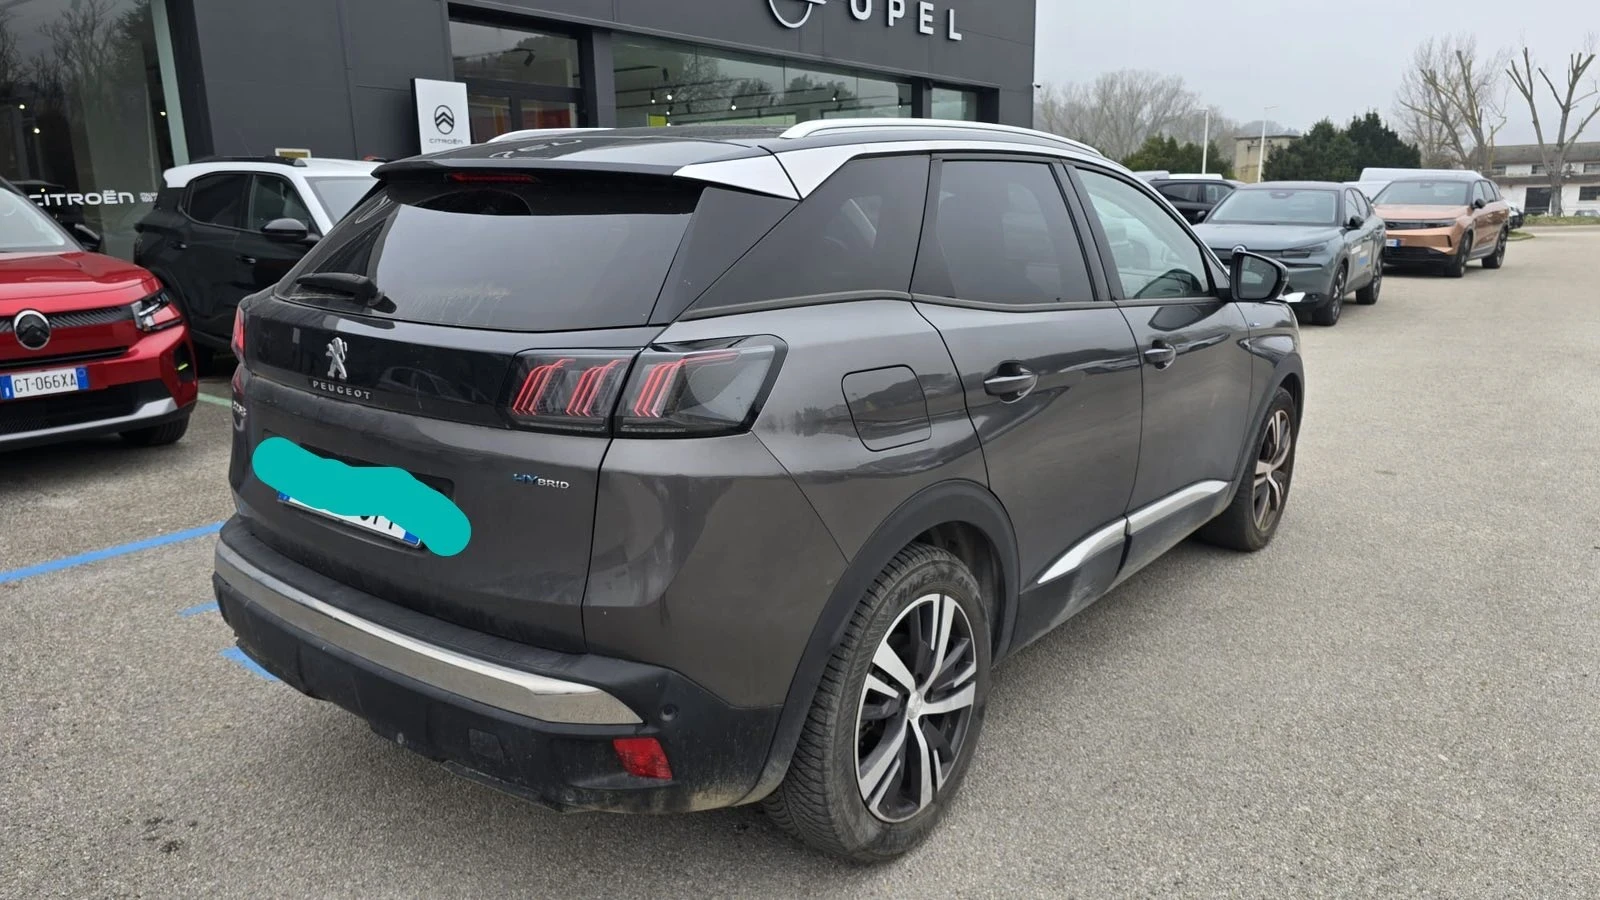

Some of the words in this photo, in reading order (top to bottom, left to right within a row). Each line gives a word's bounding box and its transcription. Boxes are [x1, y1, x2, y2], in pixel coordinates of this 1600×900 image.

[851, 0, 962, 41] OPEL
[312, 380, 371, 400] PEUGEOT
[512, 473, 570, 489] HYBRID
